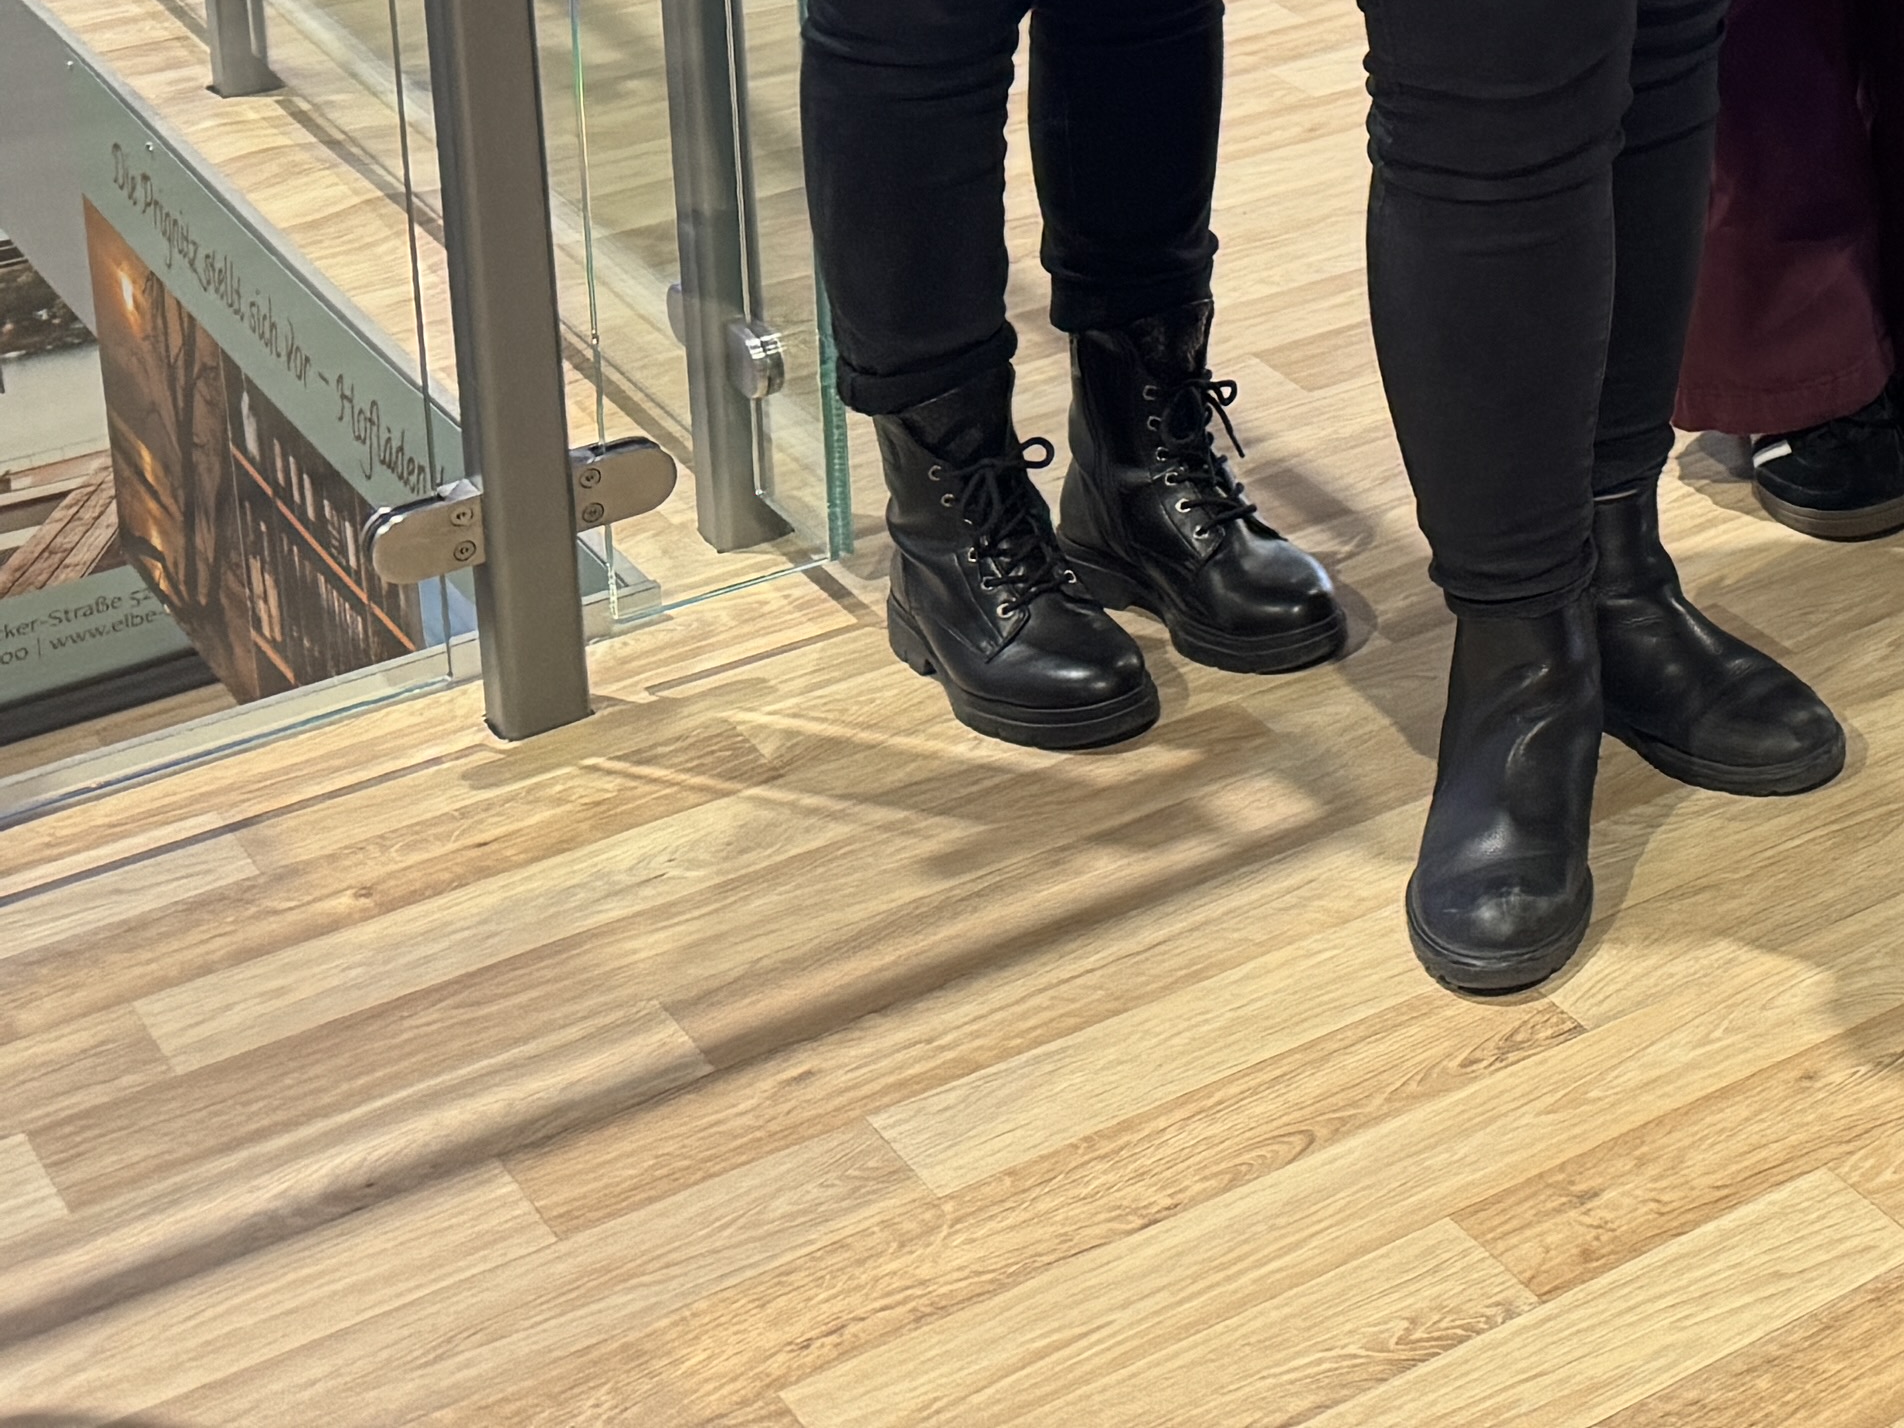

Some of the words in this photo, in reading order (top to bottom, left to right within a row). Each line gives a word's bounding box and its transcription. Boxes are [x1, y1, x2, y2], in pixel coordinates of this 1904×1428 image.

[110, 142, 138, 206] Die
[140, 172, 208, 293] Prignitz
[203, 249, 245, 323] stellt
[249, 288, 282, 359] sich
[285, 319, 312, 388] vor
